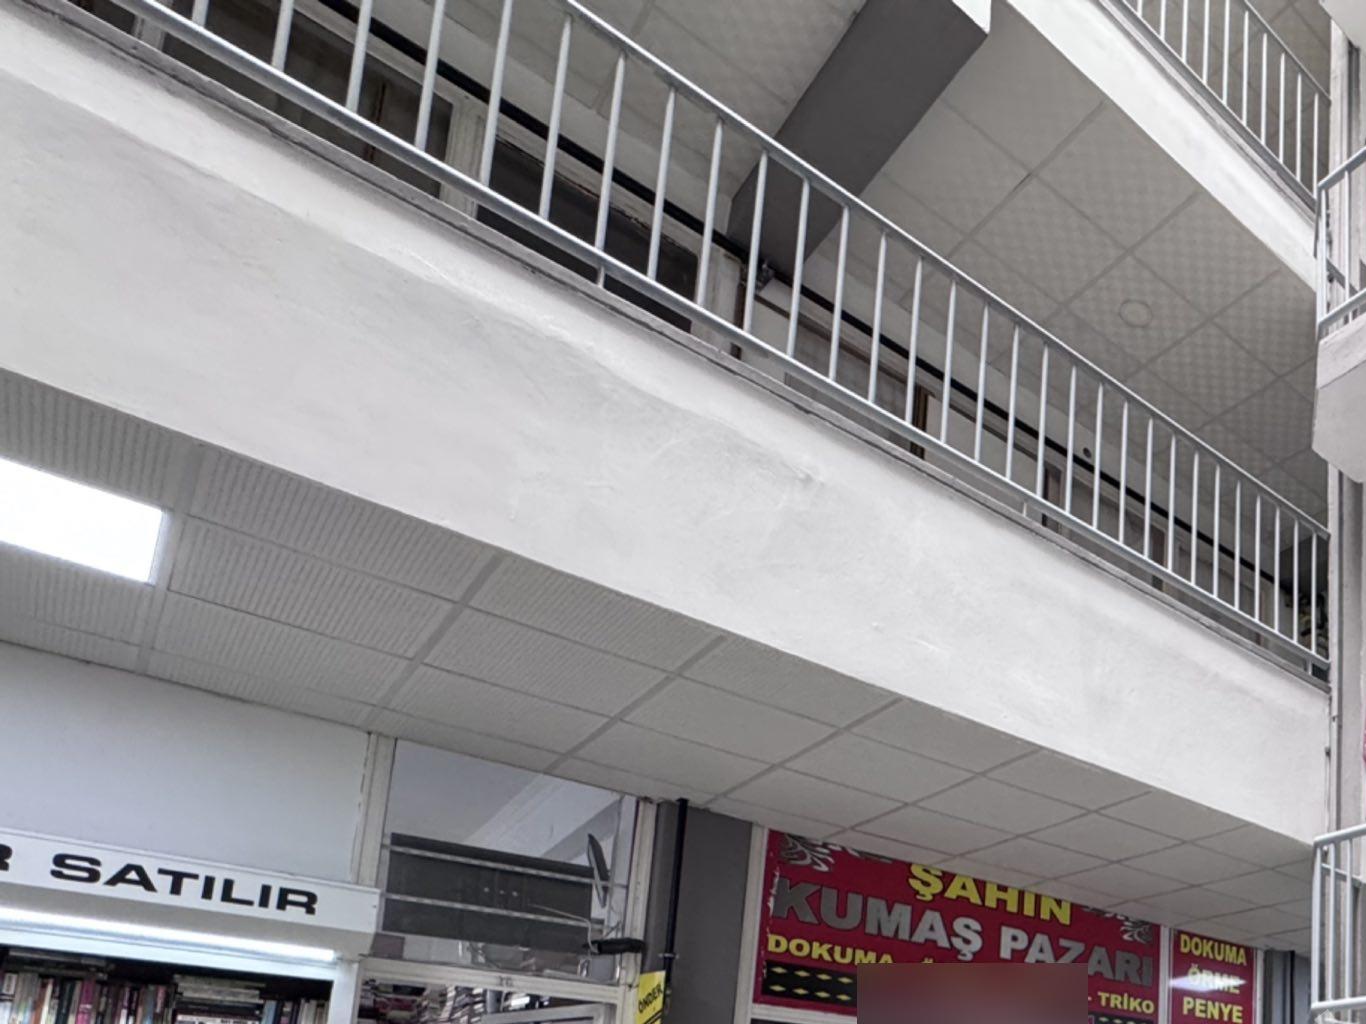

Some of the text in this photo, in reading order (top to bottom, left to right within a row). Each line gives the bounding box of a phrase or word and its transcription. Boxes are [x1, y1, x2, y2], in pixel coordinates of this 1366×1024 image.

[50, 853, 318, 915] SATILIR
[772, 877, 1154, 986] KUMAŞ PAZARI
[1180, 934, 1247, 966] DOKUMA
[1098, 991, 1155, 1014] TRİKO
[1183, 997, 1243, 1024] PENYE
